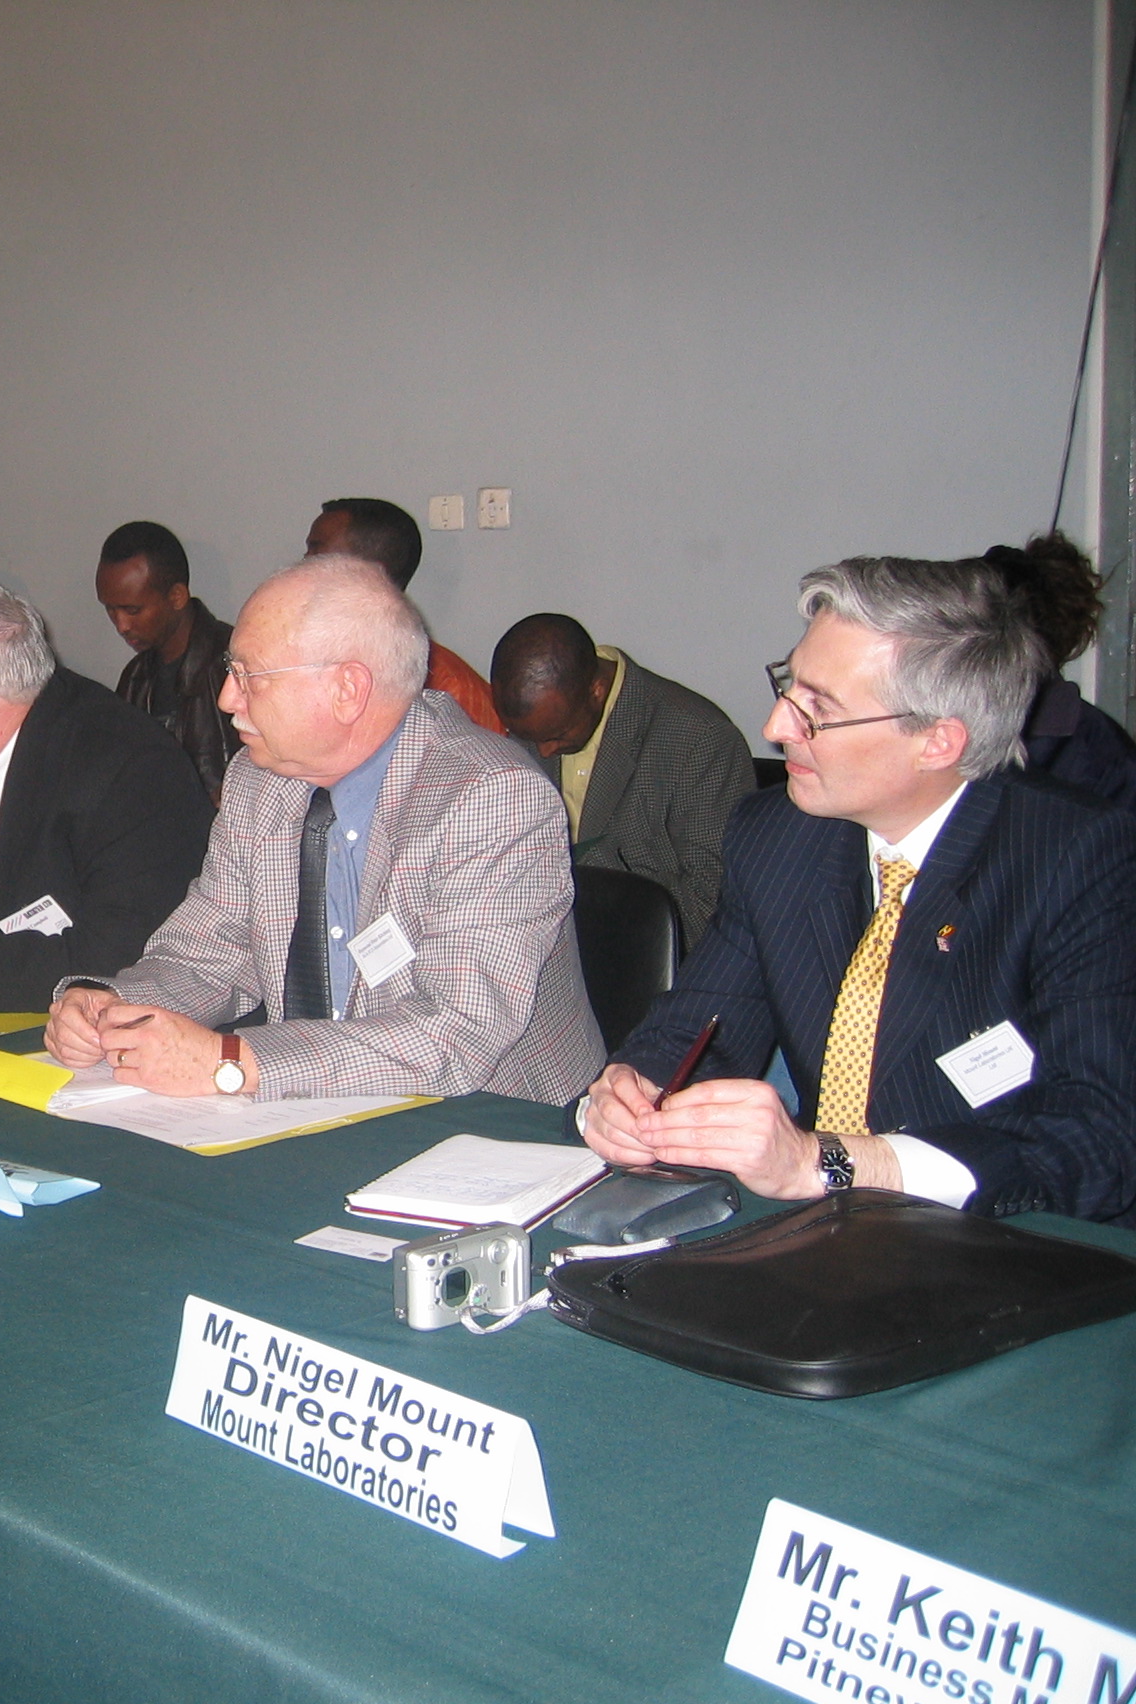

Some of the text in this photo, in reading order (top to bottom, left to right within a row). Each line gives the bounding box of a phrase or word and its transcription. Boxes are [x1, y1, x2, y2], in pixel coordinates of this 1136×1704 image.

[202, 1313, 495, 1454] Mr. Nigel Mount
[223, 1358, 442, 1472] Director
[200, 1389, 457, 1532] Mount Laboratories
[777, 1530, 862, 1610] Mr.
[887, 1574, 1064, 1693] Keith
[801, 1600, 994, 1704] Business
